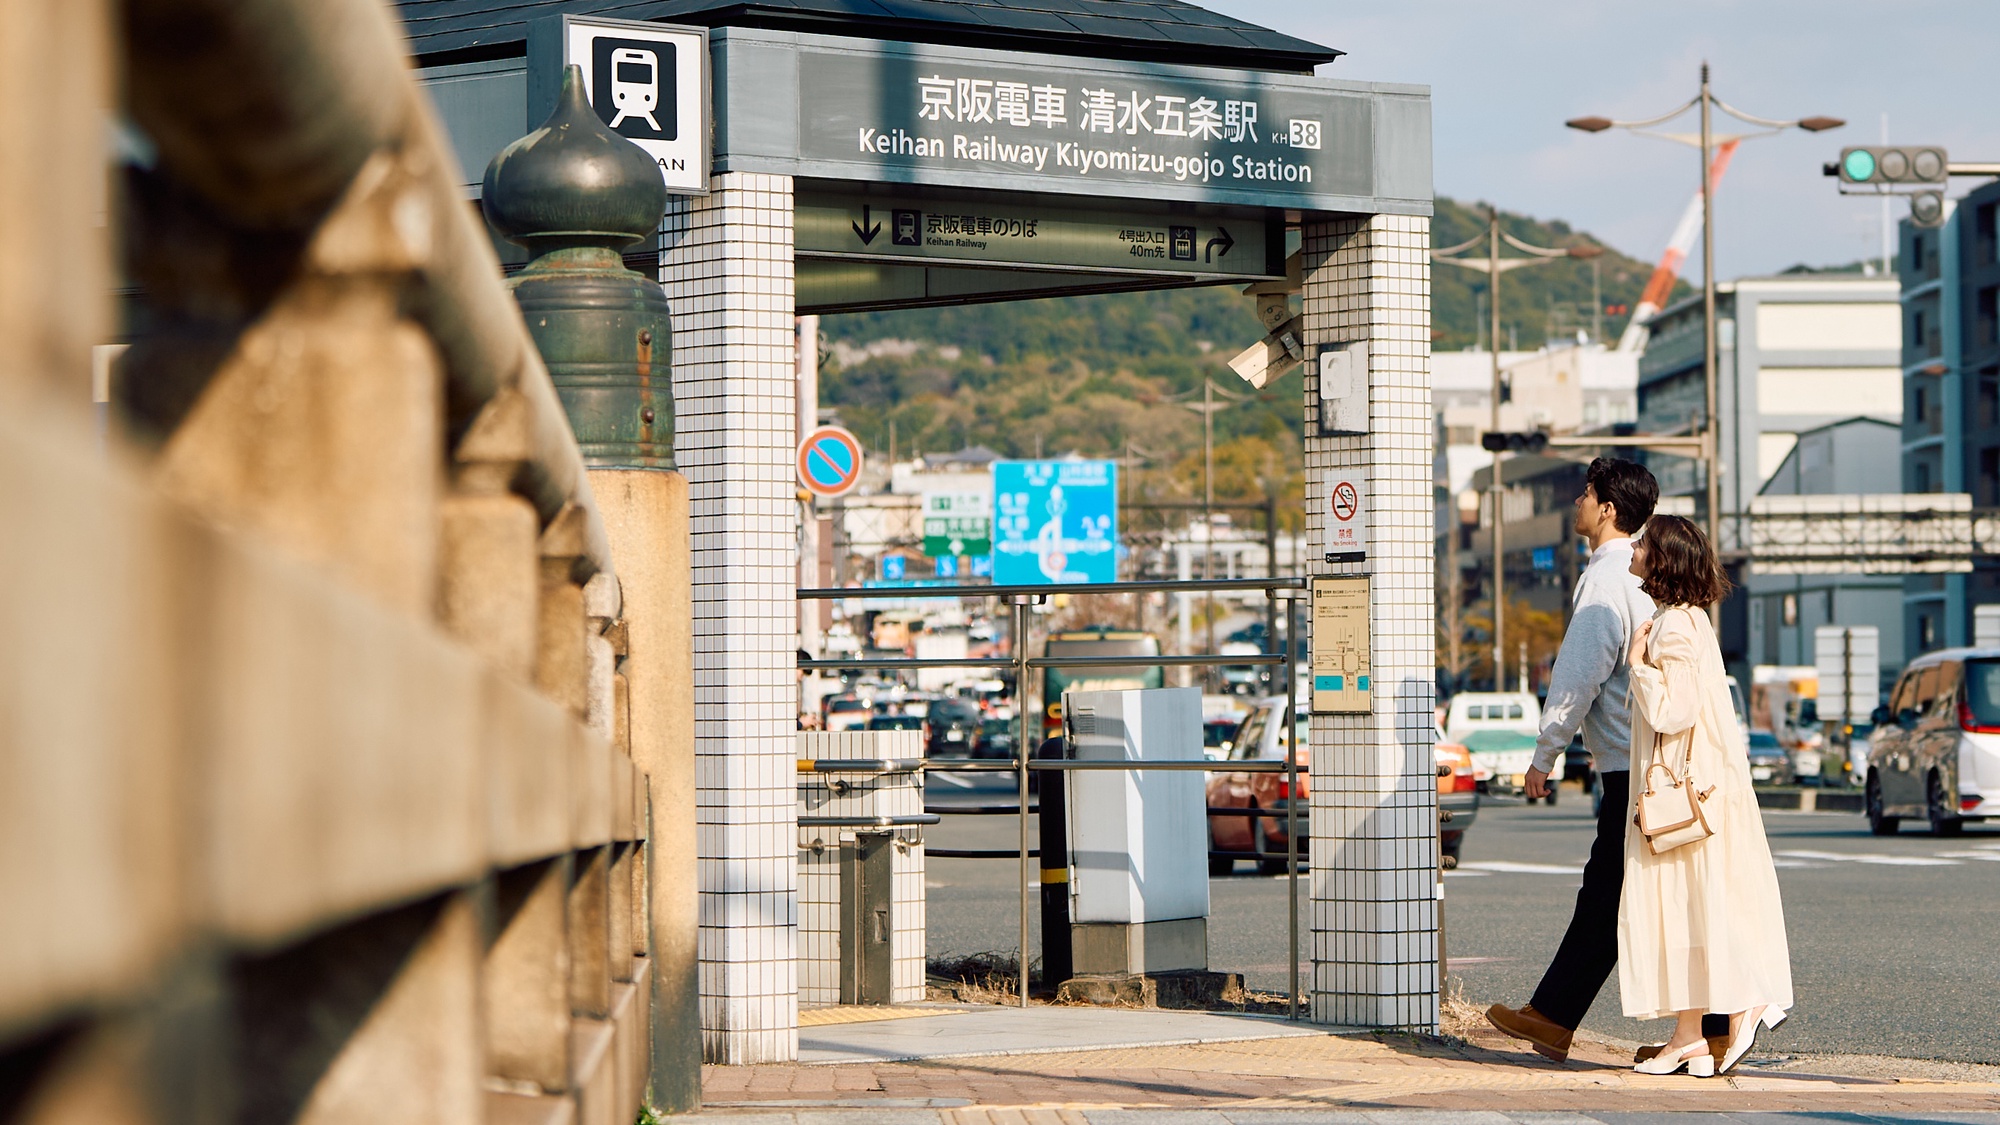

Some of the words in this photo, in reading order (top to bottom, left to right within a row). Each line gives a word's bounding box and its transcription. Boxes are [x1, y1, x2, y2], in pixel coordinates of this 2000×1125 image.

[918, 74, 1067, 129] 京阪電車
[1080, 87, 1259, 144] 清水五条駅
[1271, 132, 1288, 144] KH
[1291, 121, 1318, 147] 38
[859, 127, 945, 158] Keihan
[953, 134, 1048, 171] Railway
[1056, 142, 1224, 183] Kiyomizu-gojo
[1232, 154, 1312, 183] Station
[926, 213, 1039, 238] 京阪電車のりば
[926, 237, 954, 247] Keihan
[956, 238, 987, 250] Railway
[1118, 230, 1165, 244] 4号出入口
[1129, 244, 1165, 258] 40m先
[1338, 528, 1353, 539] 禁煙
